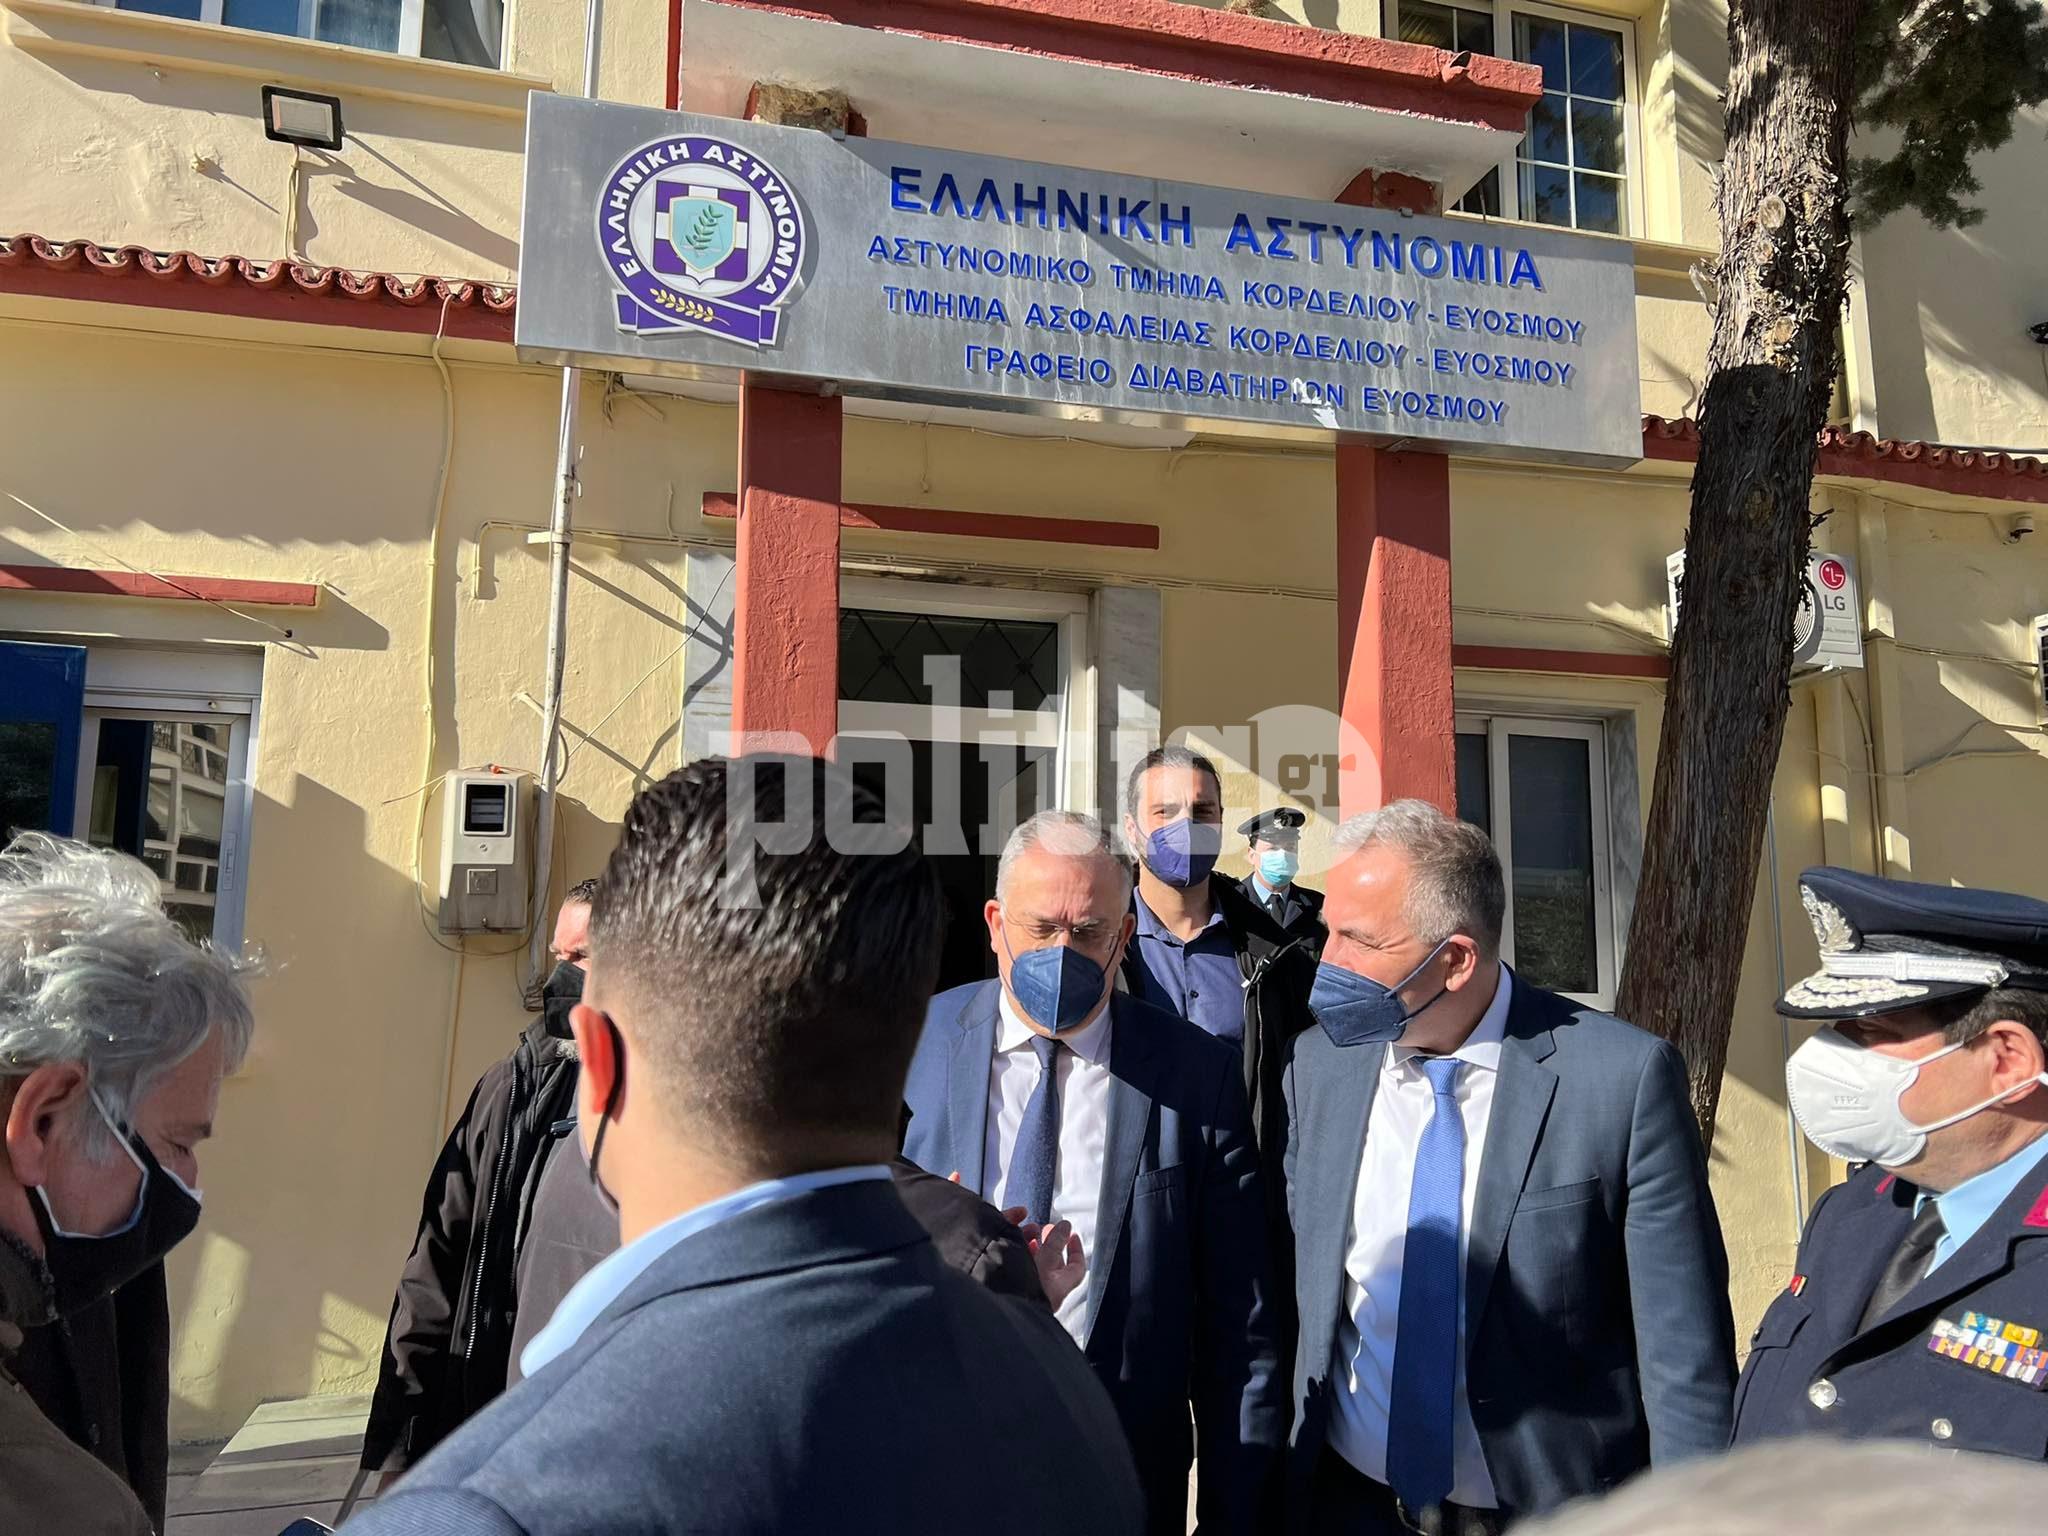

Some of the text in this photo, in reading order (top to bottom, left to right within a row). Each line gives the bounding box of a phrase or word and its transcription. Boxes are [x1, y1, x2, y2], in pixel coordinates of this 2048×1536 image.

[608, 142, 796, 295] ΕΛΛΗΝΙΚΗ ΑΣΤΥΝΟΜΙΑ
[890, 166, 1543, 291] ΕΛΛΗΝΙΚΗ ΑΣΤΥΝΟΜΙΑ
[866, 235, 1092, 284] ΑΣΤΥΝΟΜΙΚΟ
[1110, 264, 1226, 300] ΤΜΗΜΑ
[1243, 280, 1417, 321] ΚΟΡΔΕΛΙΟΥ
[1445, 304, 1582, 342] ΕΥΟΣΜΟΥ
[883, 285, 1008, 323] ΤΜΗΜΑ
[1024, 303, 1211, 346] ΑΣΦΑΛΕΙΑΣ
[1229, 325, 1403, 366] ΚΟΡΔΕΛΙΟΥ
[1433, 348, 1570, 384] ΕΥΟΣΜΟΥ
[965, 345, 1111, 383] ΓΡΑΦΕΙΟ
[1362, 387, 1504, 422] ΕΥΟΣΜΟΥ
[1824, 594, 1846, 611] LG
